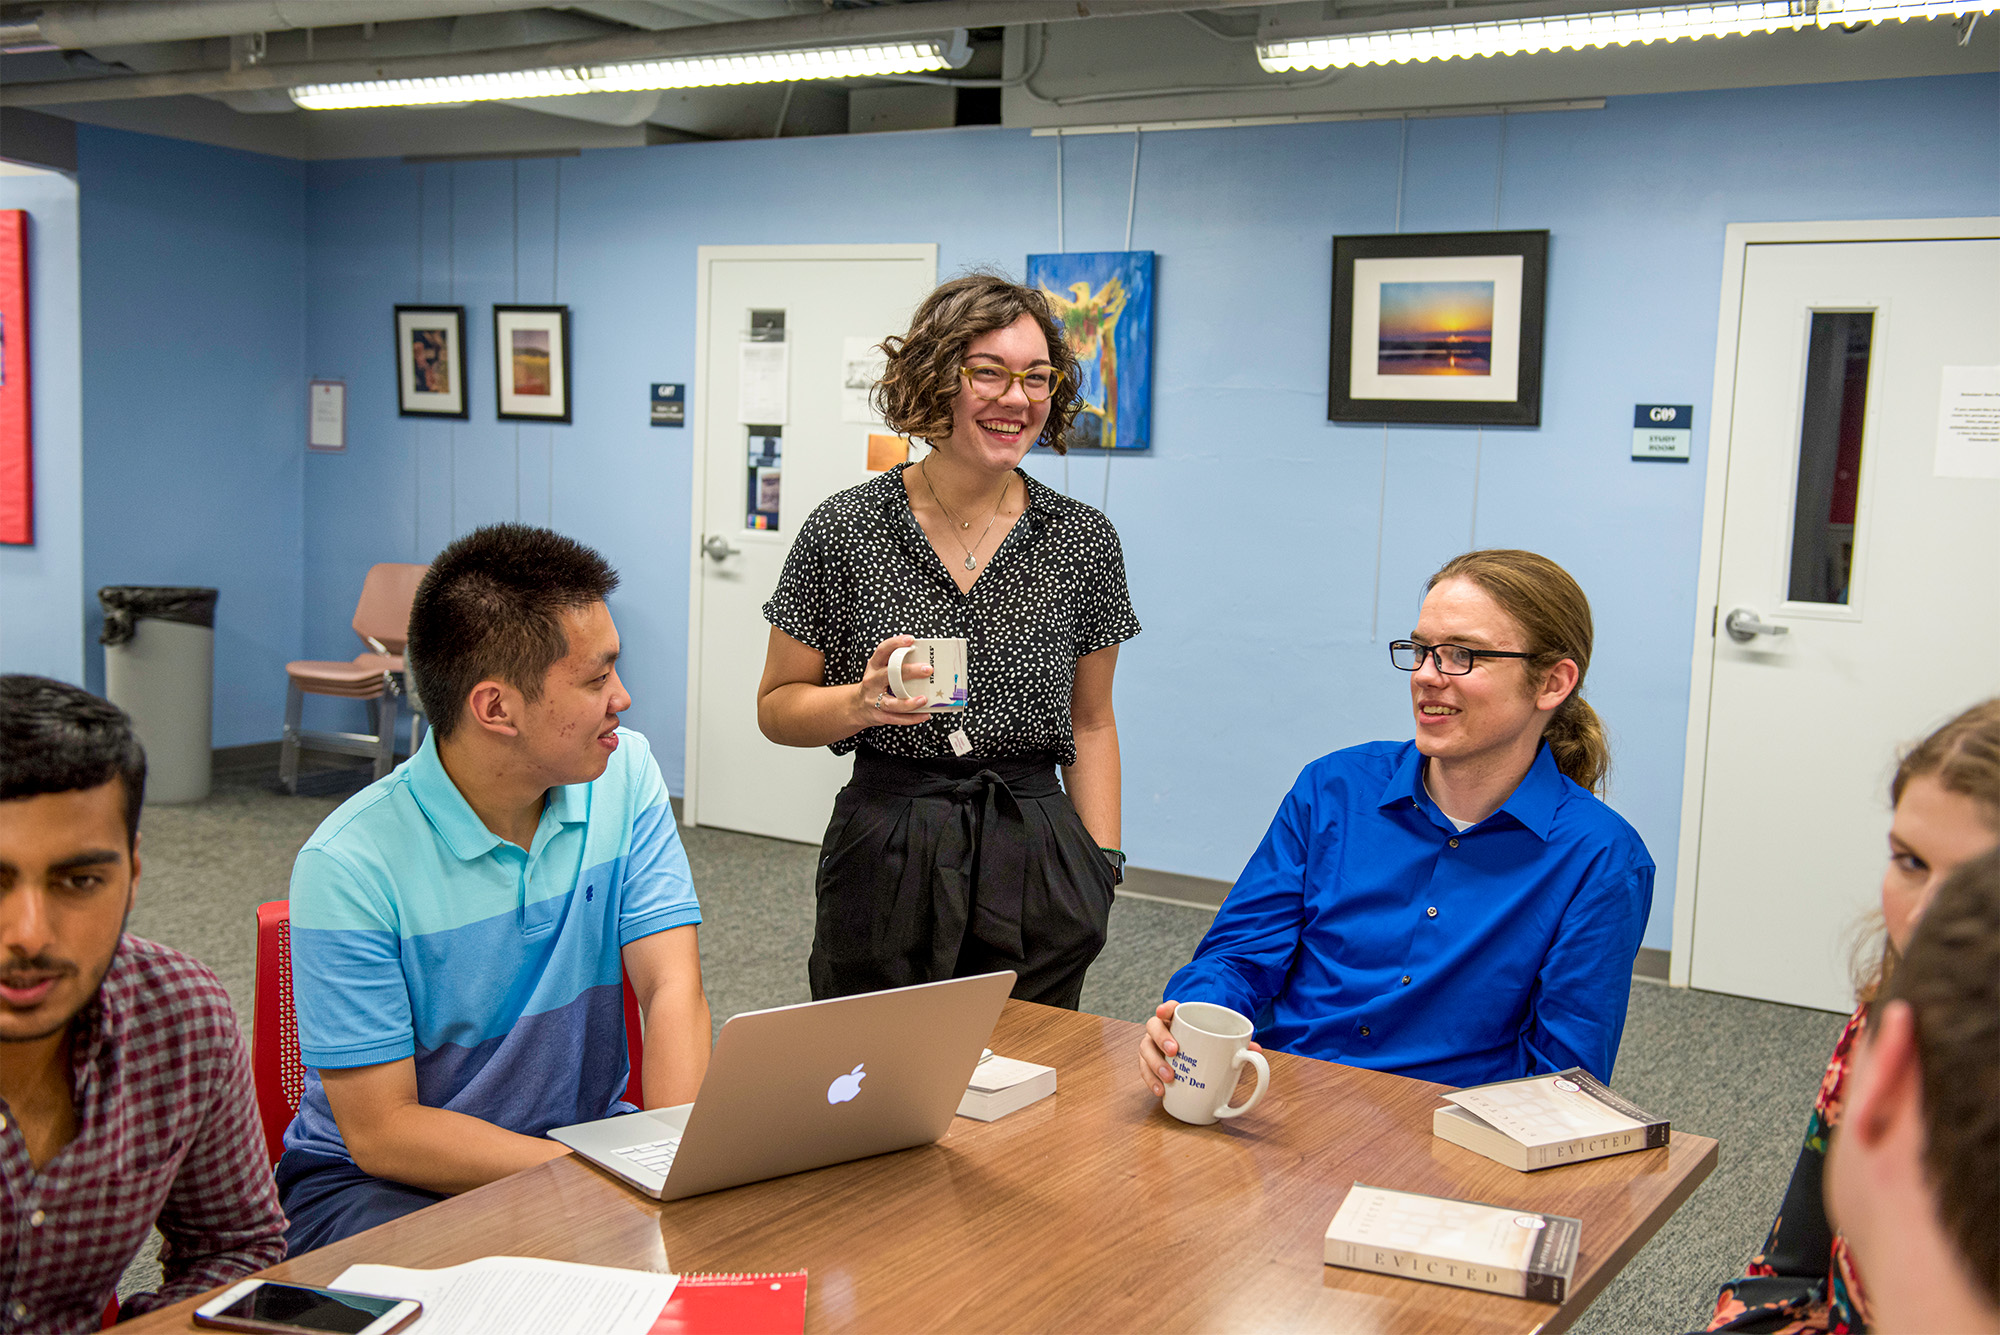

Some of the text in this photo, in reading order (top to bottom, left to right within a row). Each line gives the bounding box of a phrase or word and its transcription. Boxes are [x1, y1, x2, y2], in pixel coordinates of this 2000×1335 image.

[1649, 407, 1677, 422] G09
[1649, 435, 1676, 443] STUDY
[1171, 1058, 1191, 1074] to the
[1173, 1069, 1206, 1089] lars' Den
[1556, 1134, 1632, 1158] EVICTED
[1374, 1252, 1498, 1284] EVICTED
